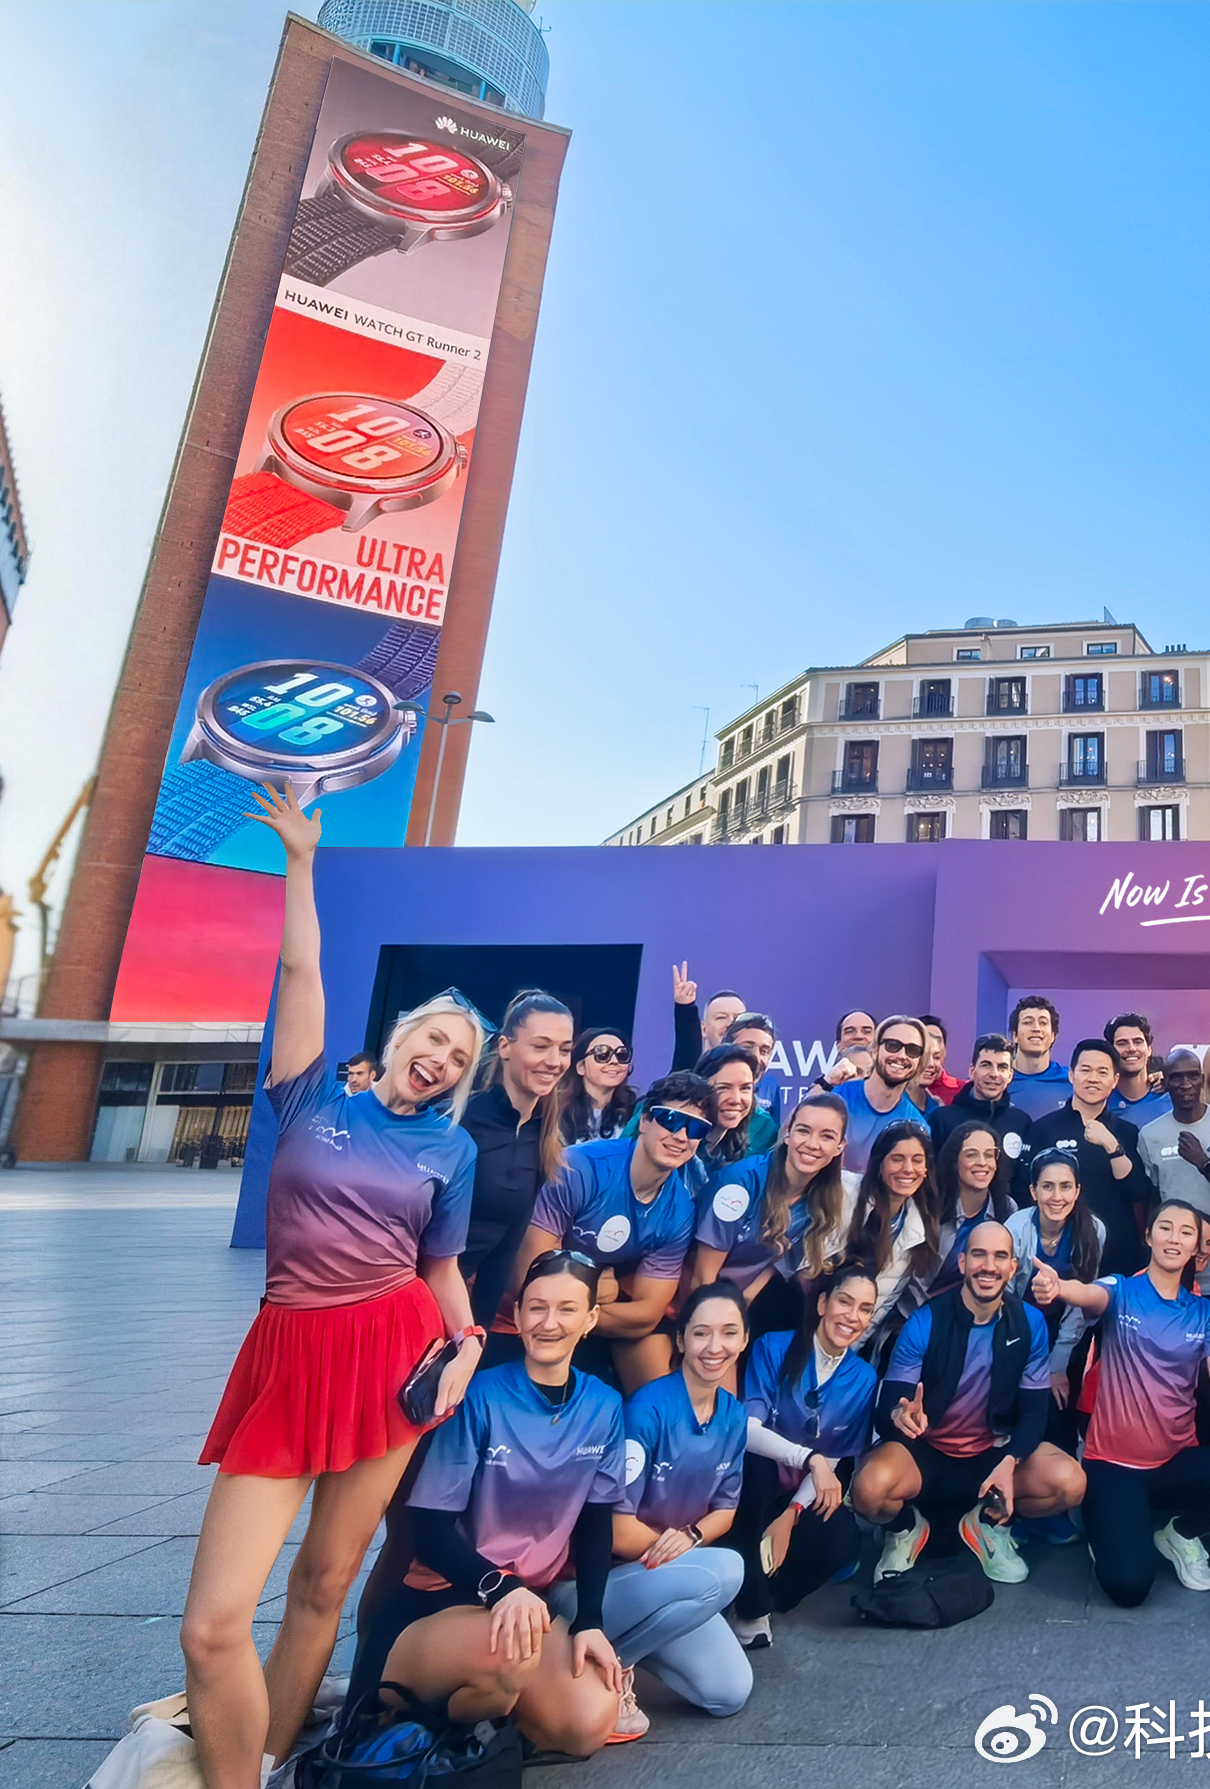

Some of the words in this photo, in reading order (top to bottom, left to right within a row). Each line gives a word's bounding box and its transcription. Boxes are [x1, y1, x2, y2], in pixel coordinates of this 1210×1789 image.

[460, 127, 510, 150] HUAWEI
[284, 290, 349, 320] HUAWEI
[354, 313, 403, 338] WATCH
[405, 330, 424, 343] GT
[426, 336, 471, 357] Runner
[473, 350, 481, 360] 2
[216, 537, 444, 621] PERFORMANCE
[356, 535, 445, 584] ULTRA
[1099, 871, 1170, 915] Now
[1175, 874, 1207, 908] Is
